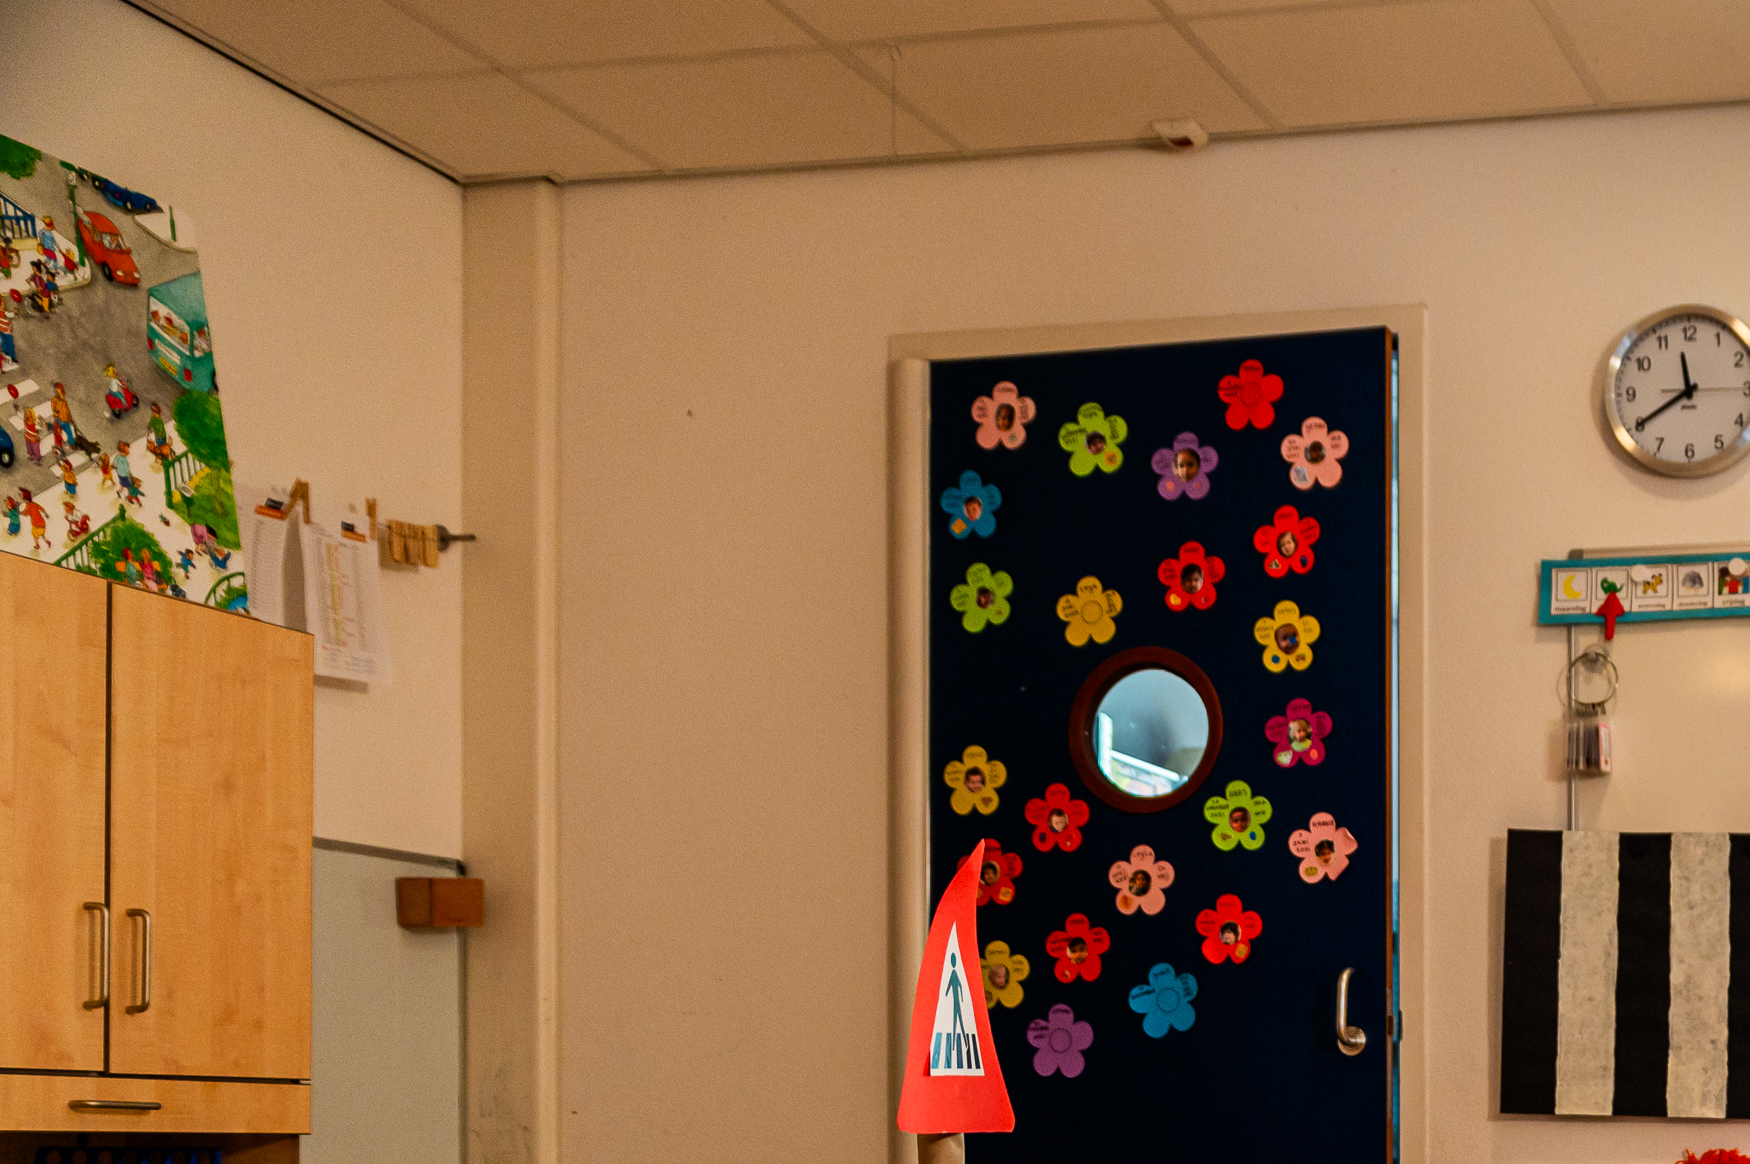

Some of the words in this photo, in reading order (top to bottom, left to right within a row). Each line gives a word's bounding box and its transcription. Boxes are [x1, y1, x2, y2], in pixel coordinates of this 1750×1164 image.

[1682, 325, 1697, 342] 12
[1715, 332, 1721, 347] 1
[1657, 335, 1668, 350] 11
[1636, 356, 1651, 371] 10
[1734, 351, 1744, 368] 2
[1626, 386, 1636, 402] 9
[1635, 416, 1646, 432] 8
[1734, 413, 1744, 428] 4
[1655, 437, 1664, 452] 7
[1714, 434, 1724, 450] 5
[1684, 443, 1695, 459] 6
